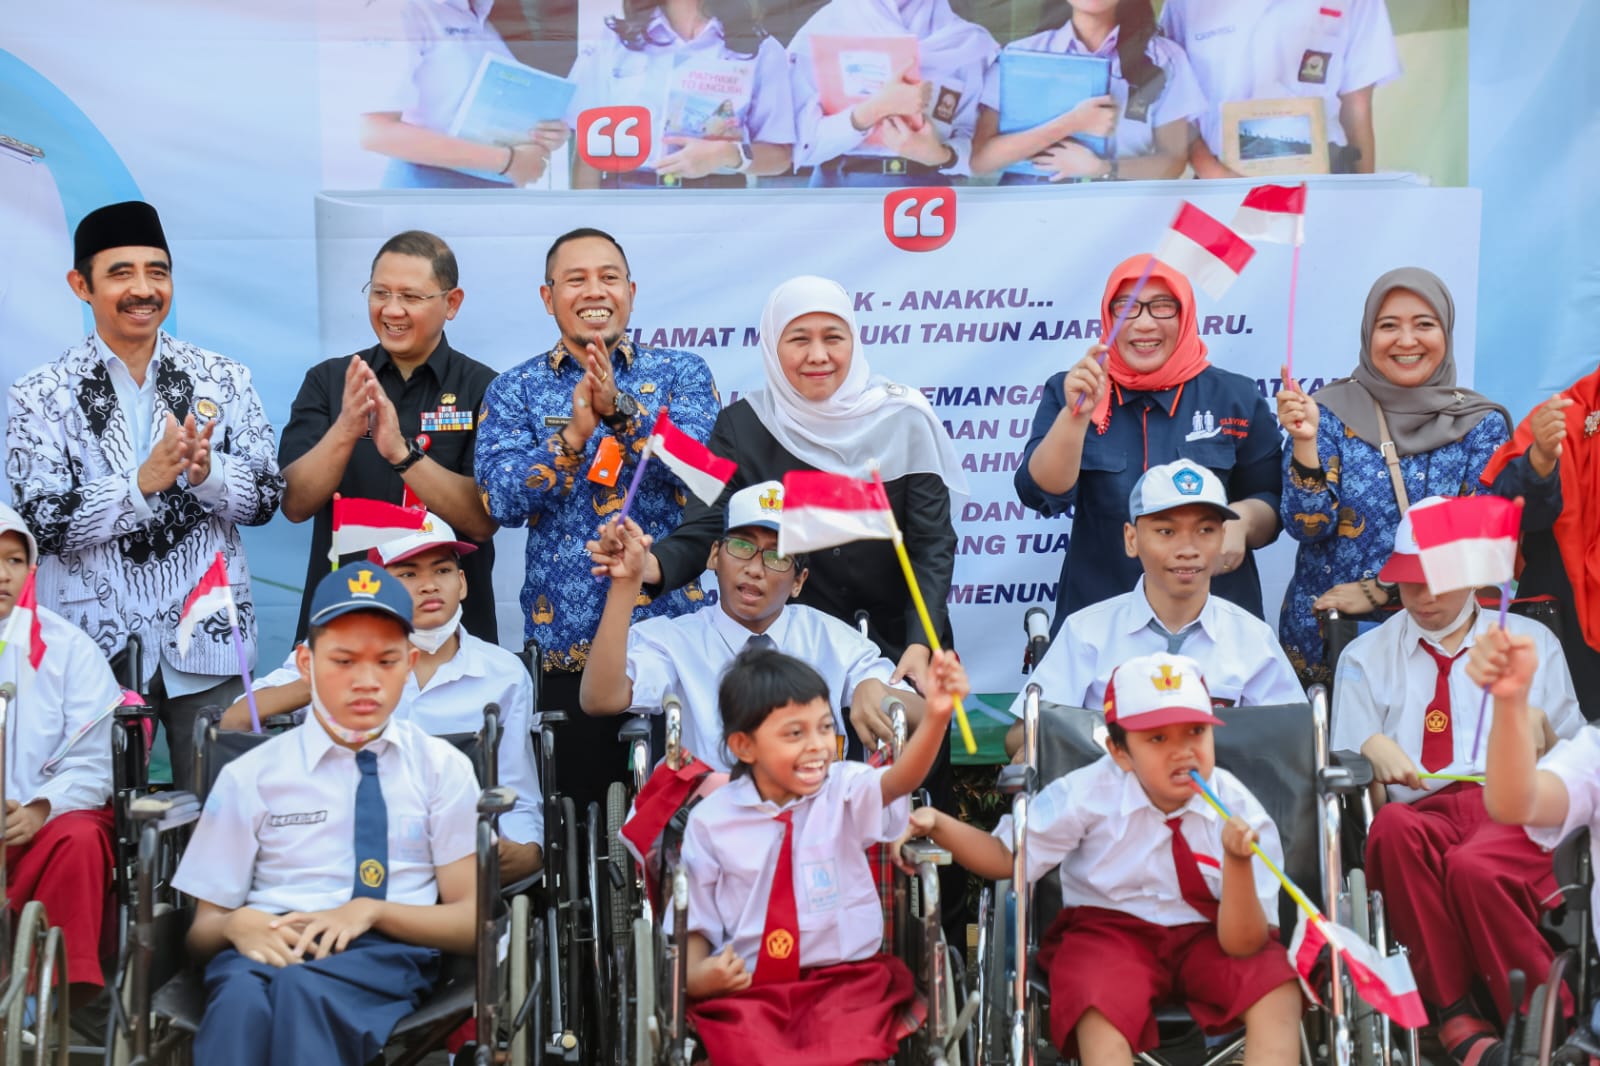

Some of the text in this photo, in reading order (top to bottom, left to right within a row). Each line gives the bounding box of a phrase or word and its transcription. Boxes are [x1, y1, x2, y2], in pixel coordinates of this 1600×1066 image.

[847, 291, 876, 312] K
[899, 288, 1053, 311] ANAKKU...
[625, 326, 735, 348] LAMAT
[860, 324, 911, 345] UKI
[920, 322, 1022, 343] TAHUN
[1029, 319, 1102, 342] AJAR
[1196, 314, 1254, 336] RU.
[919, 384, 1045, 406] EMANGA
[942, 418, 1030, 440] AAN U
[961, 451, 1025, 473] AHM
[961, 501, 1026, 522] DAN
[954, 533, 1071, 555] NG TUA
[946, 582, 1059, 605] MENUN
